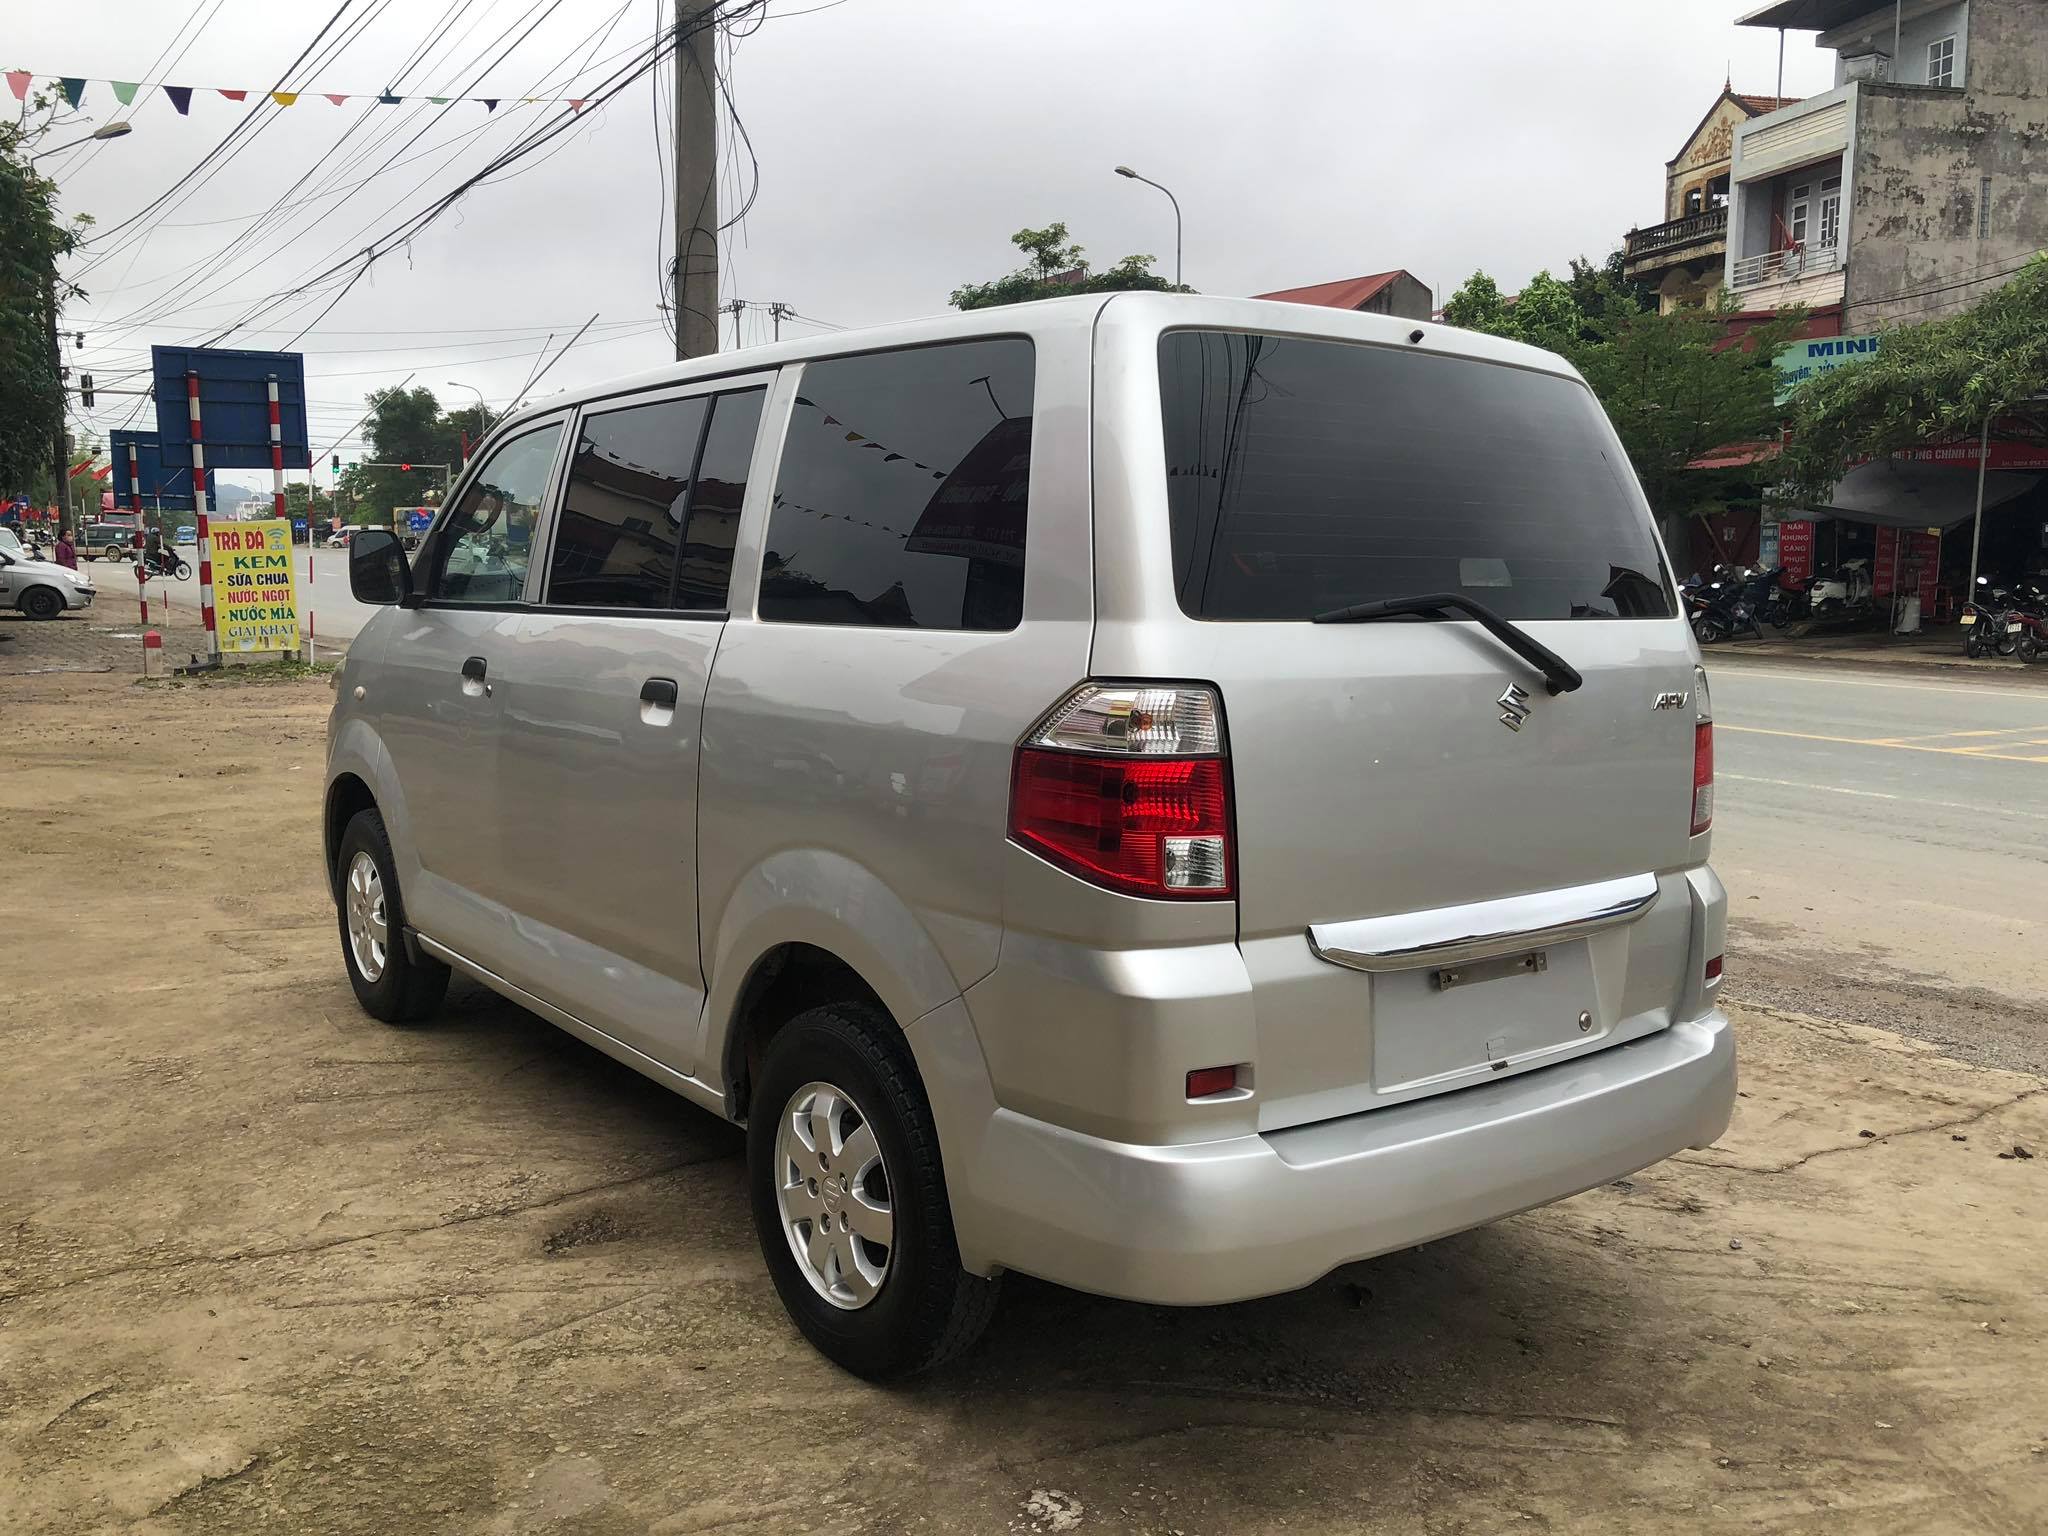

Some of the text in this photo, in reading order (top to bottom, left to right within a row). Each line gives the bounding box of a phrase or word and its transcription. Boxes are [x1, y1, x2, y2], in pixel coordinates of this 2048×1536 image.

[213, 526, 265, 551] TRÀ ĐÁ
[234, 555, 287, 569] KEM
[227, 572, 289, 587] SỮA CHUA
[261, 588, 290, 604] NGỌT
[229, 605, 267, 622] NƯỚC
